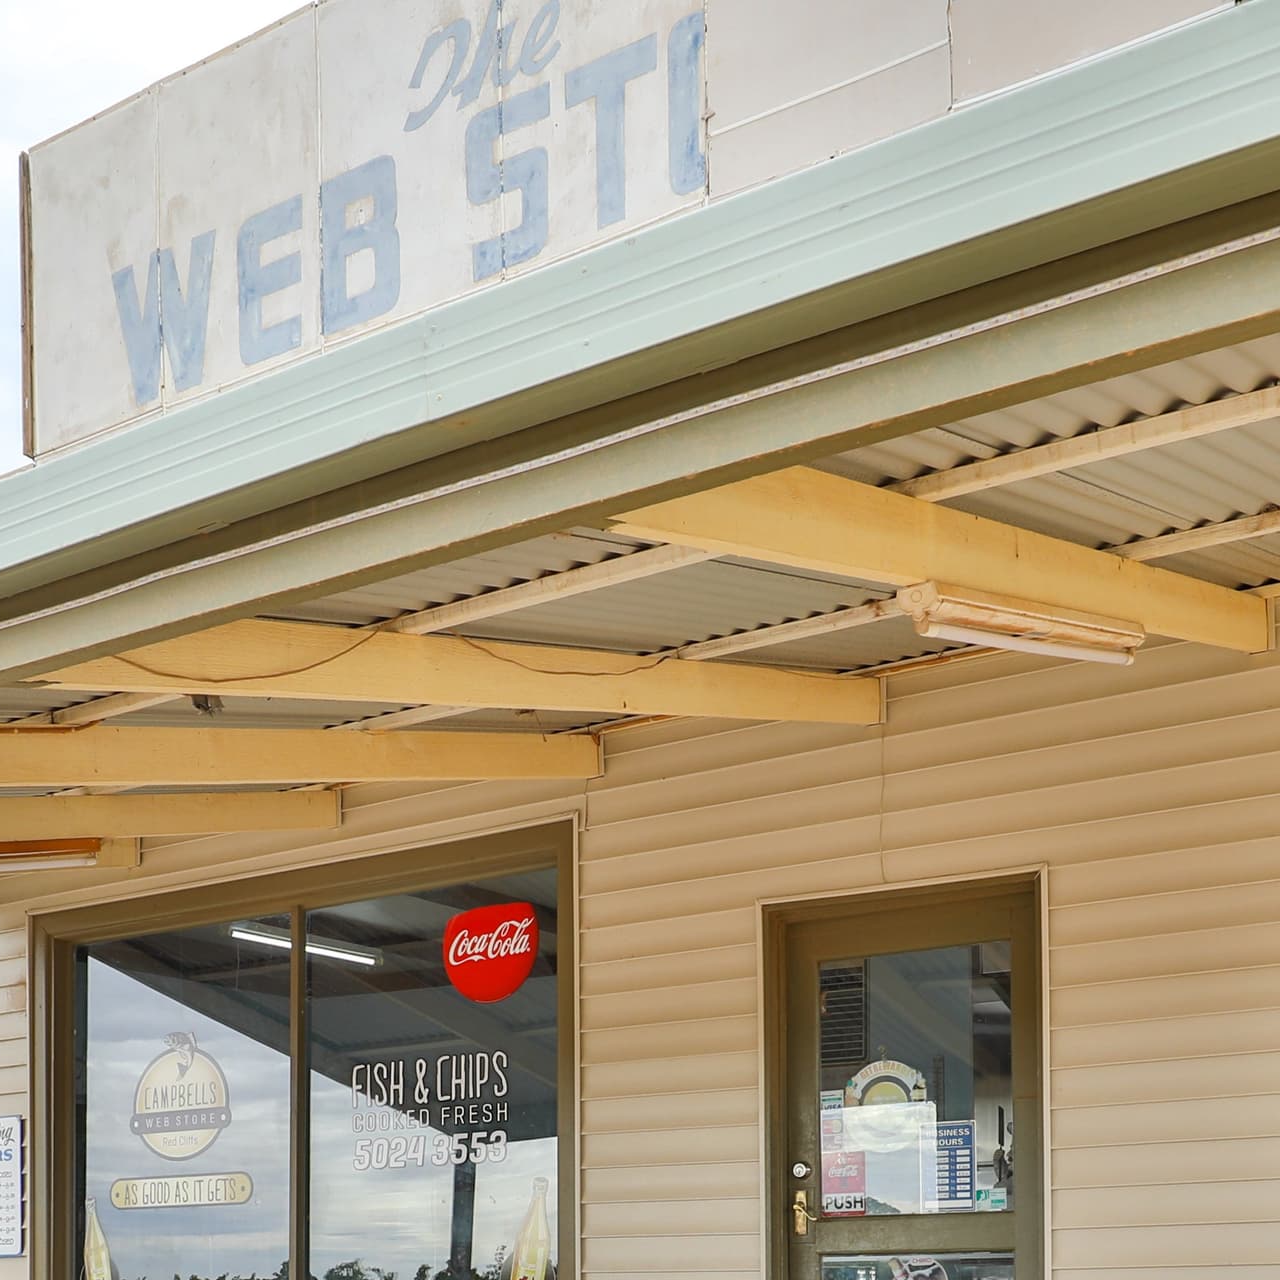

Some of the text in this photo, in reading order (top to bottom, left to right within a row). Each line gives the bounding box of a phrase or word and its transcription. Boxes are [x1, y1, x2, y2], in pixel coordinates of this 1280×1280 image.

[403, 0, 561, 132] The
[111, 155, 401, 409] WEB
[352, 1051, 508, 1108] FISH & CHIPS
[144, 1081, 217, 1110] CAMPBELLS
[145, 1113, 216, 1129] WEB STORE
[352, 1102, 508, 1133] COOKED FRESH
[162, 1137, 177, 1147] Red
[124, 1178, 236, 1206] AS GOOD AS IT GETS
[825, 1195, 864, 1210] PUSH
